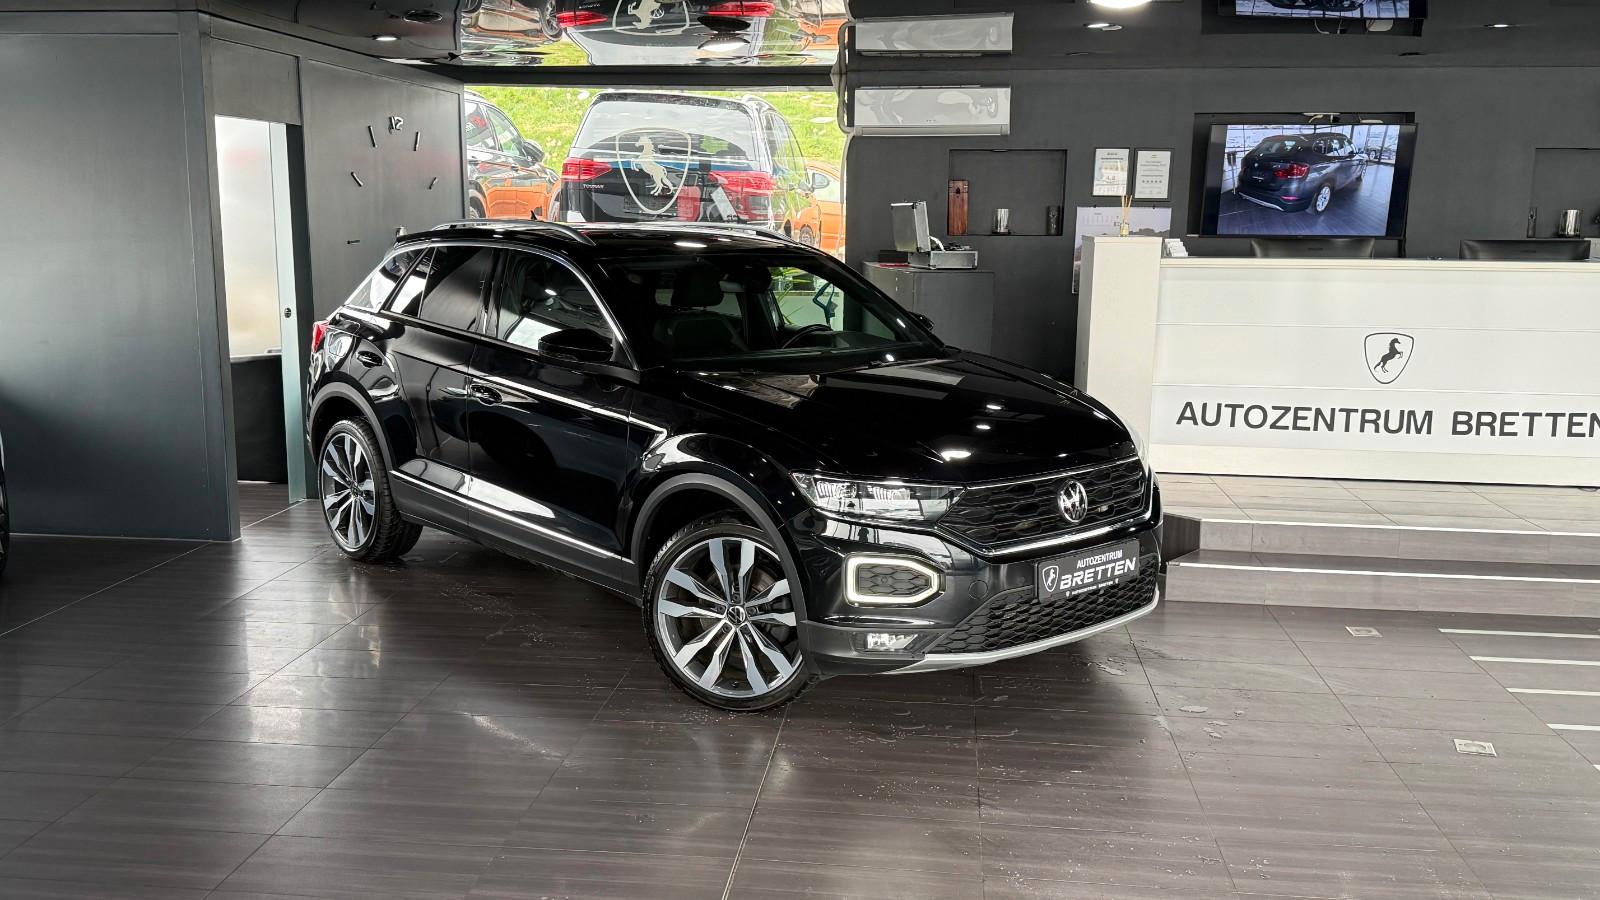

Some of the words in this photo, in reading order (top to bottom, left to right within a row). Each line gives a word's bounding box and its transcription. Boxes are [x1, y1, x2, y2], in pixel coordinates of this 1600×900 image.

[1176, 401, 1433, 435] AUTOZENTRUM
[1059, 557, 1137, 590] BRETTEN
[1077, 549, 1123, 569] AUTOZENTRUM
